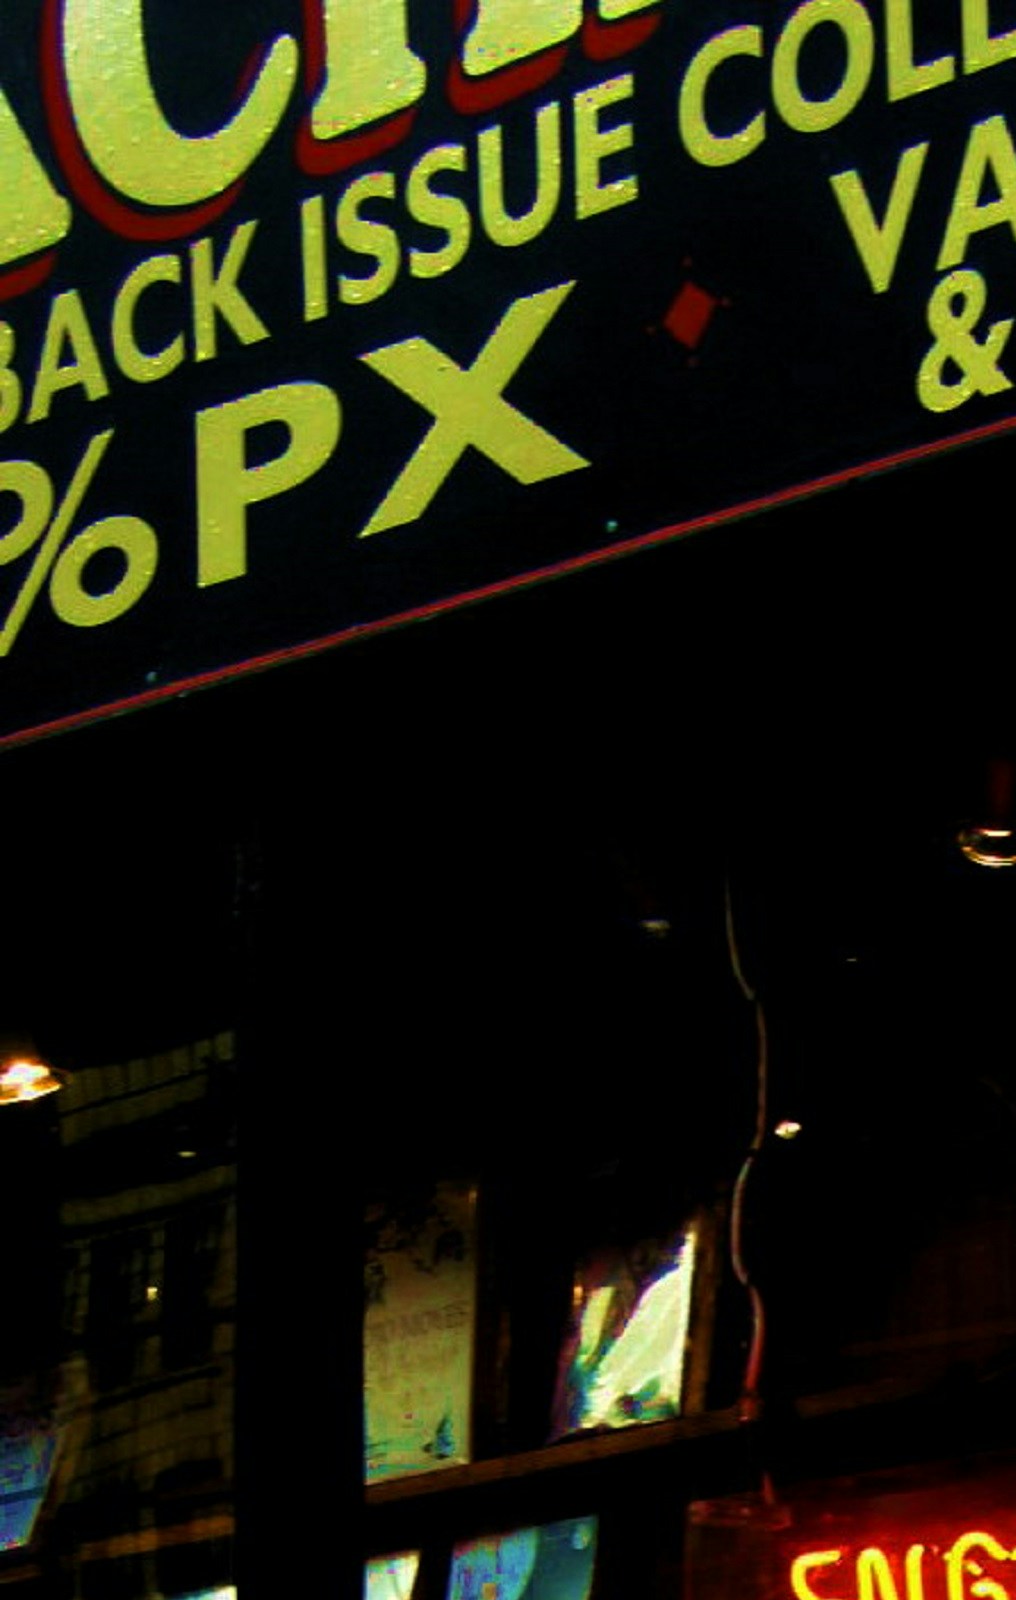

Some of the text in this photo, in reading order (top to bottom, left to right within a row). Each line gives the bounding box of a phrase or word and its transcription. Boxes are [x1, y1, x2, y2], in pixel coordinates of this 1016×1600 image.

[301, 75, 639, 321] ISSUE
[196, 280, 590, 588] PX
[918, 270, 1013, 413] &
